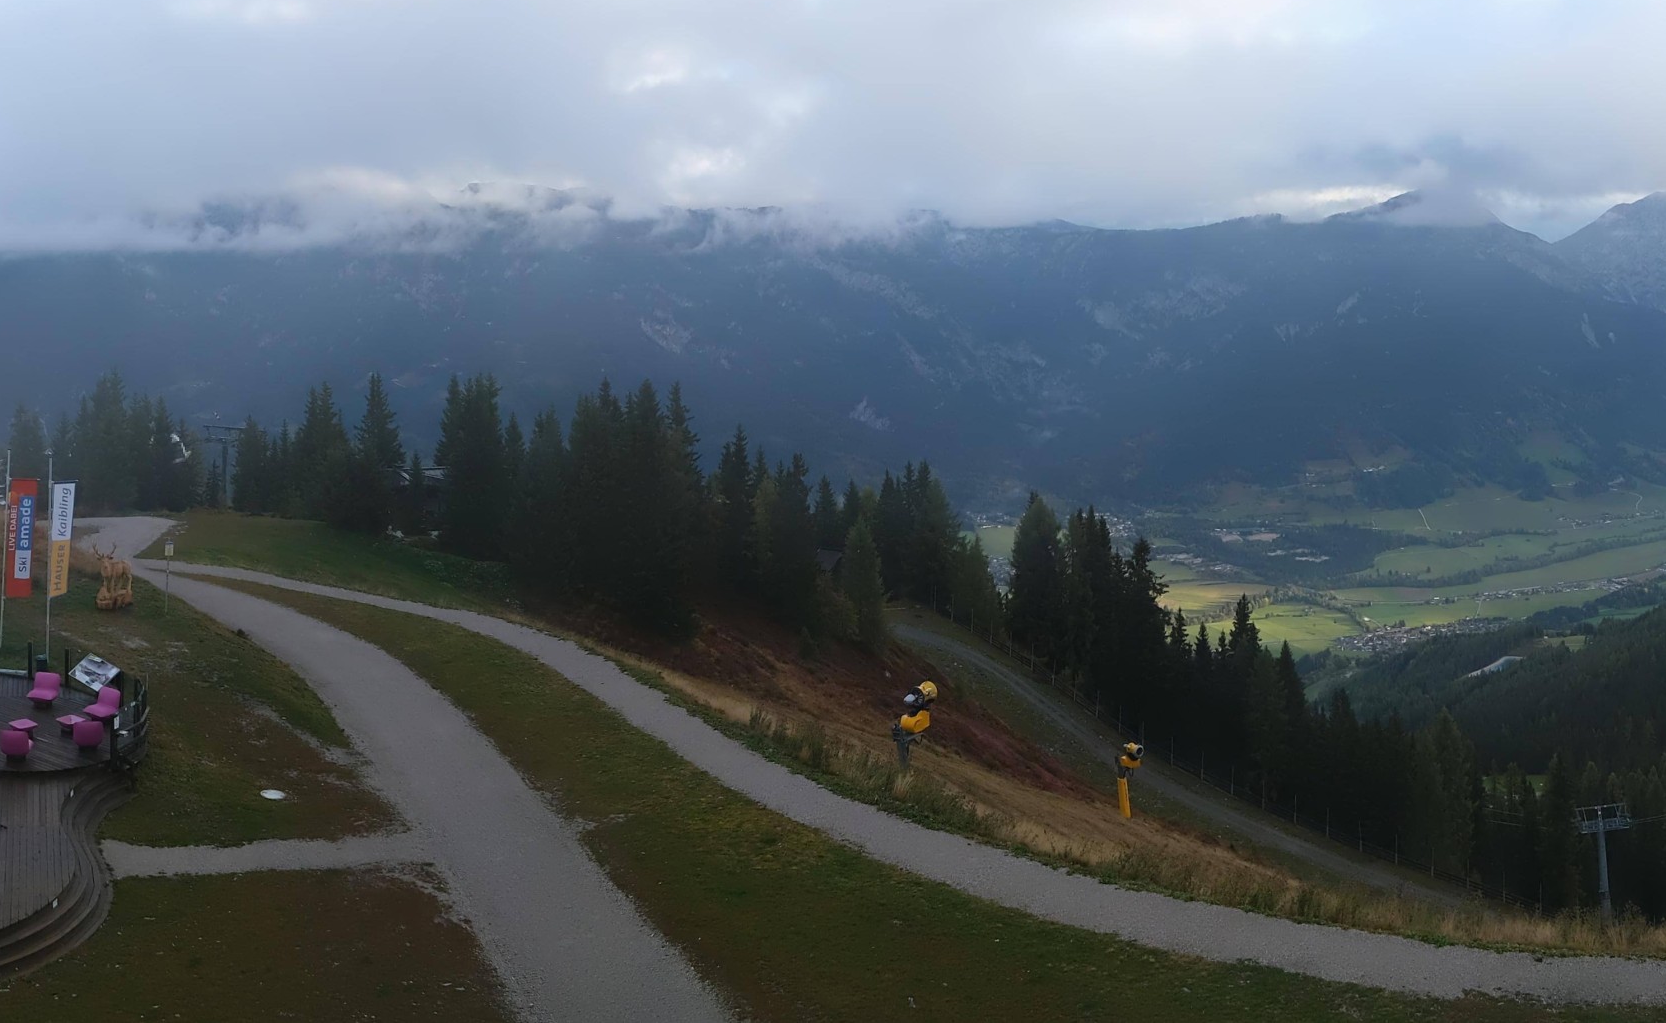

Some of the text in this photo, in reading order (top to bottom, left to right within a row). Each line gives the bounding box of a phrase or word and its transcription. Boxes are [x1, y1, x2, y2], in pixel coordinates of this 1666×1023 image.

[10, 505, 18, 529] DABEI
[19, 498, 32, 572] Ski amade
[54, 487, 72, 591] HAUSER Kaibling
